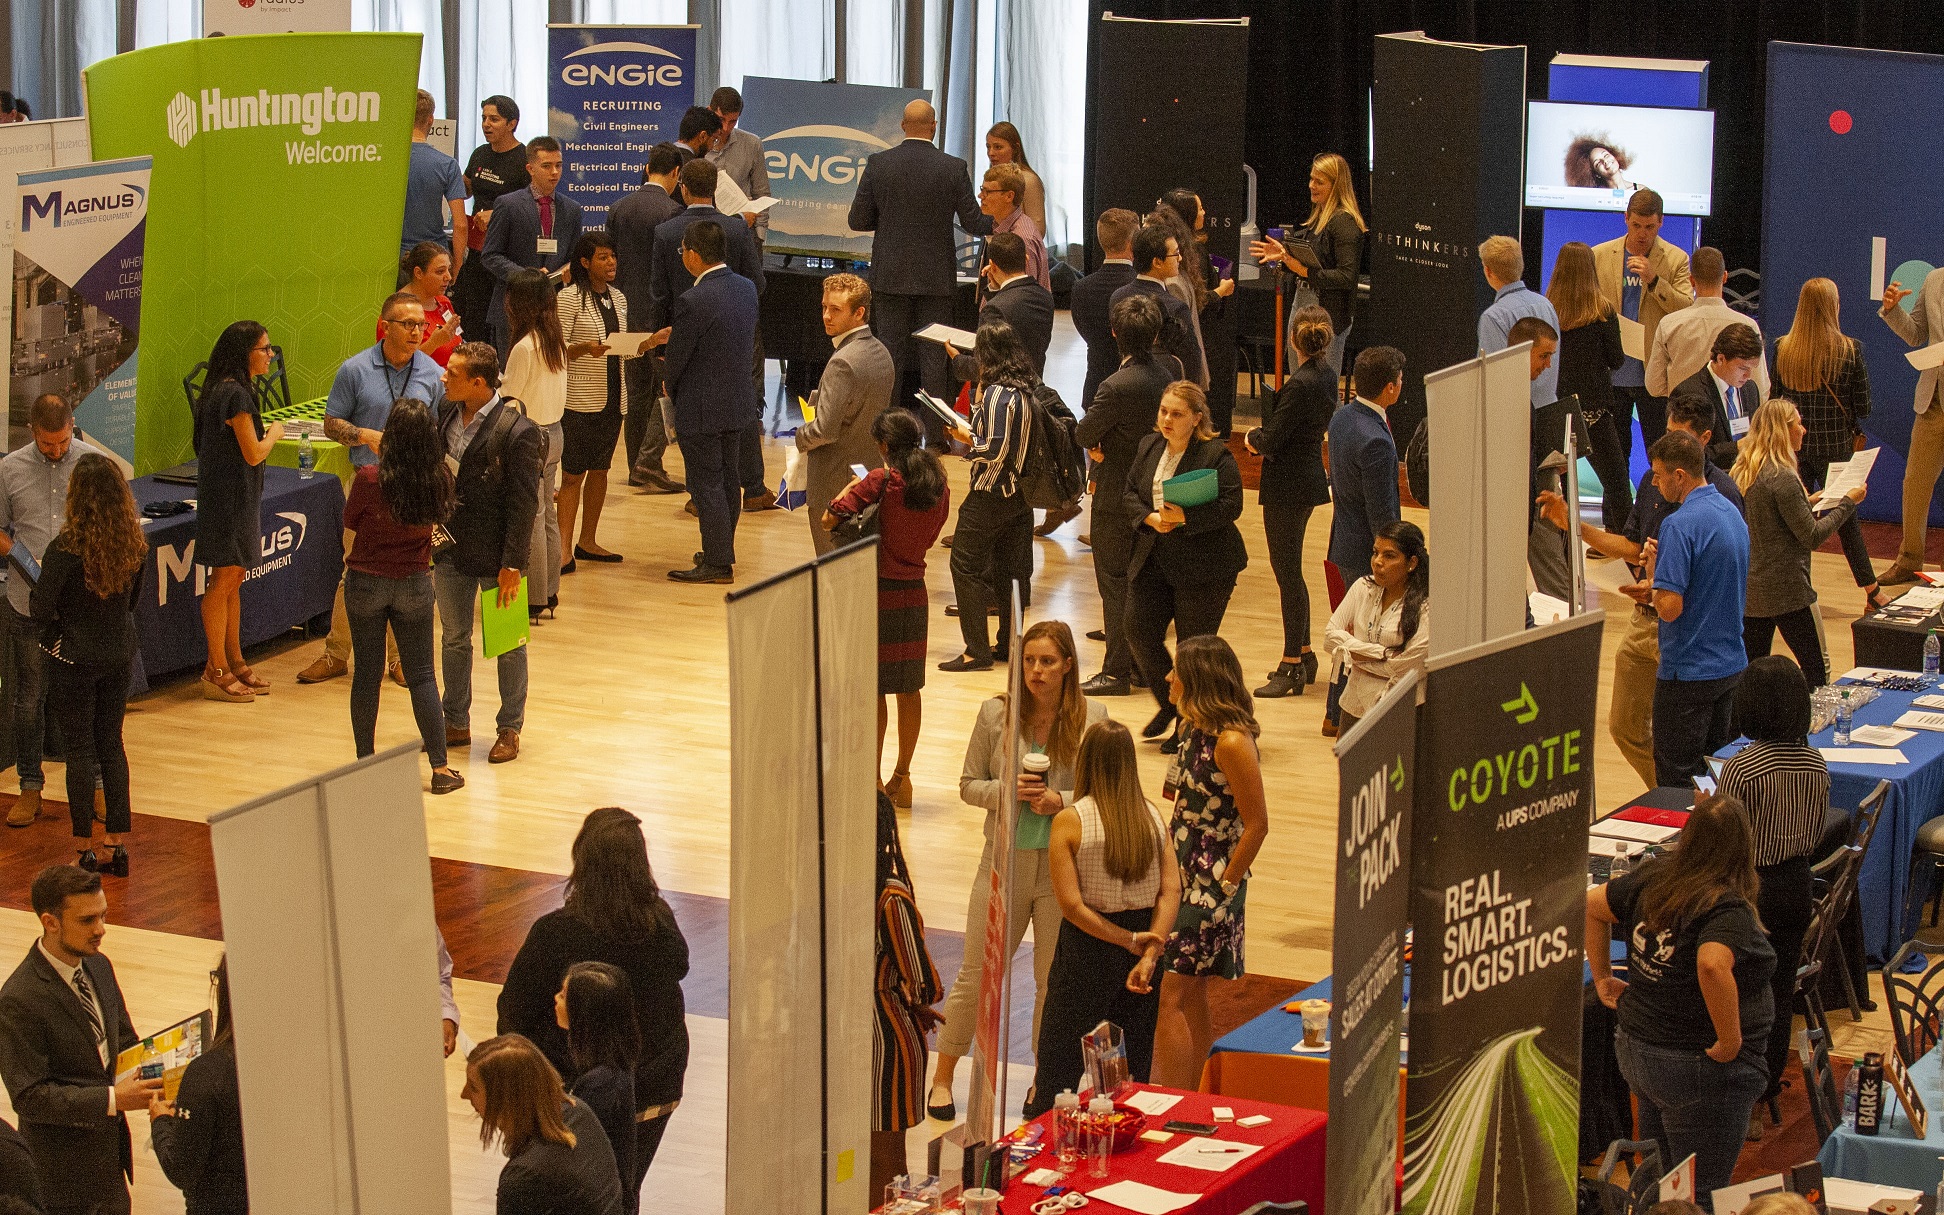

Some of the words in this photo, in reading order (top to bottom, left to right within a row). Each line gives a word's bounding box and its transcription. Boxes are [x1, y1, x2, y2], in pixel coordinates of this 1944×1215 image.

[200, 86, 381, 136] Huntington
[583, 101, 662, 111] RECRUITING
[583, 122, 606, 131] Civil
[609, 122, 659, 132] Engineers
[285, 141, 382, 165] Welcome.
[565, 142, 623, 151] Mechanical
[570, 162, 618, 172] Electrical
[568, 183, 620, 193] Ecological
[21, 190, 135, 233] MAGNUS
[63, 214, 98, 227] ENGINEERED
[98, 211, 133, 223] EQUIPMENT
[1415, 222, 1432, 232] dyson
[1378, 233, 1469, 258] RETHINKERS
[252, 553, 292, 581] EQUIPMENT
[1448, 729, 1581, 813] COYOTE
[1345, 763, 1388, 858] JOIN
[1496, 814, 1505, 832] A
[1506, 805, 1528, 829] UPS
[1528, 789, 1580, 821] COMPANY
[1359, 811, 1402, 910] PACK
[1444, 869, 1513, 925] REAL.
[1442, 898, 1533, 965] SMART.
[1858, 1079, 1879, 1127] BARK
